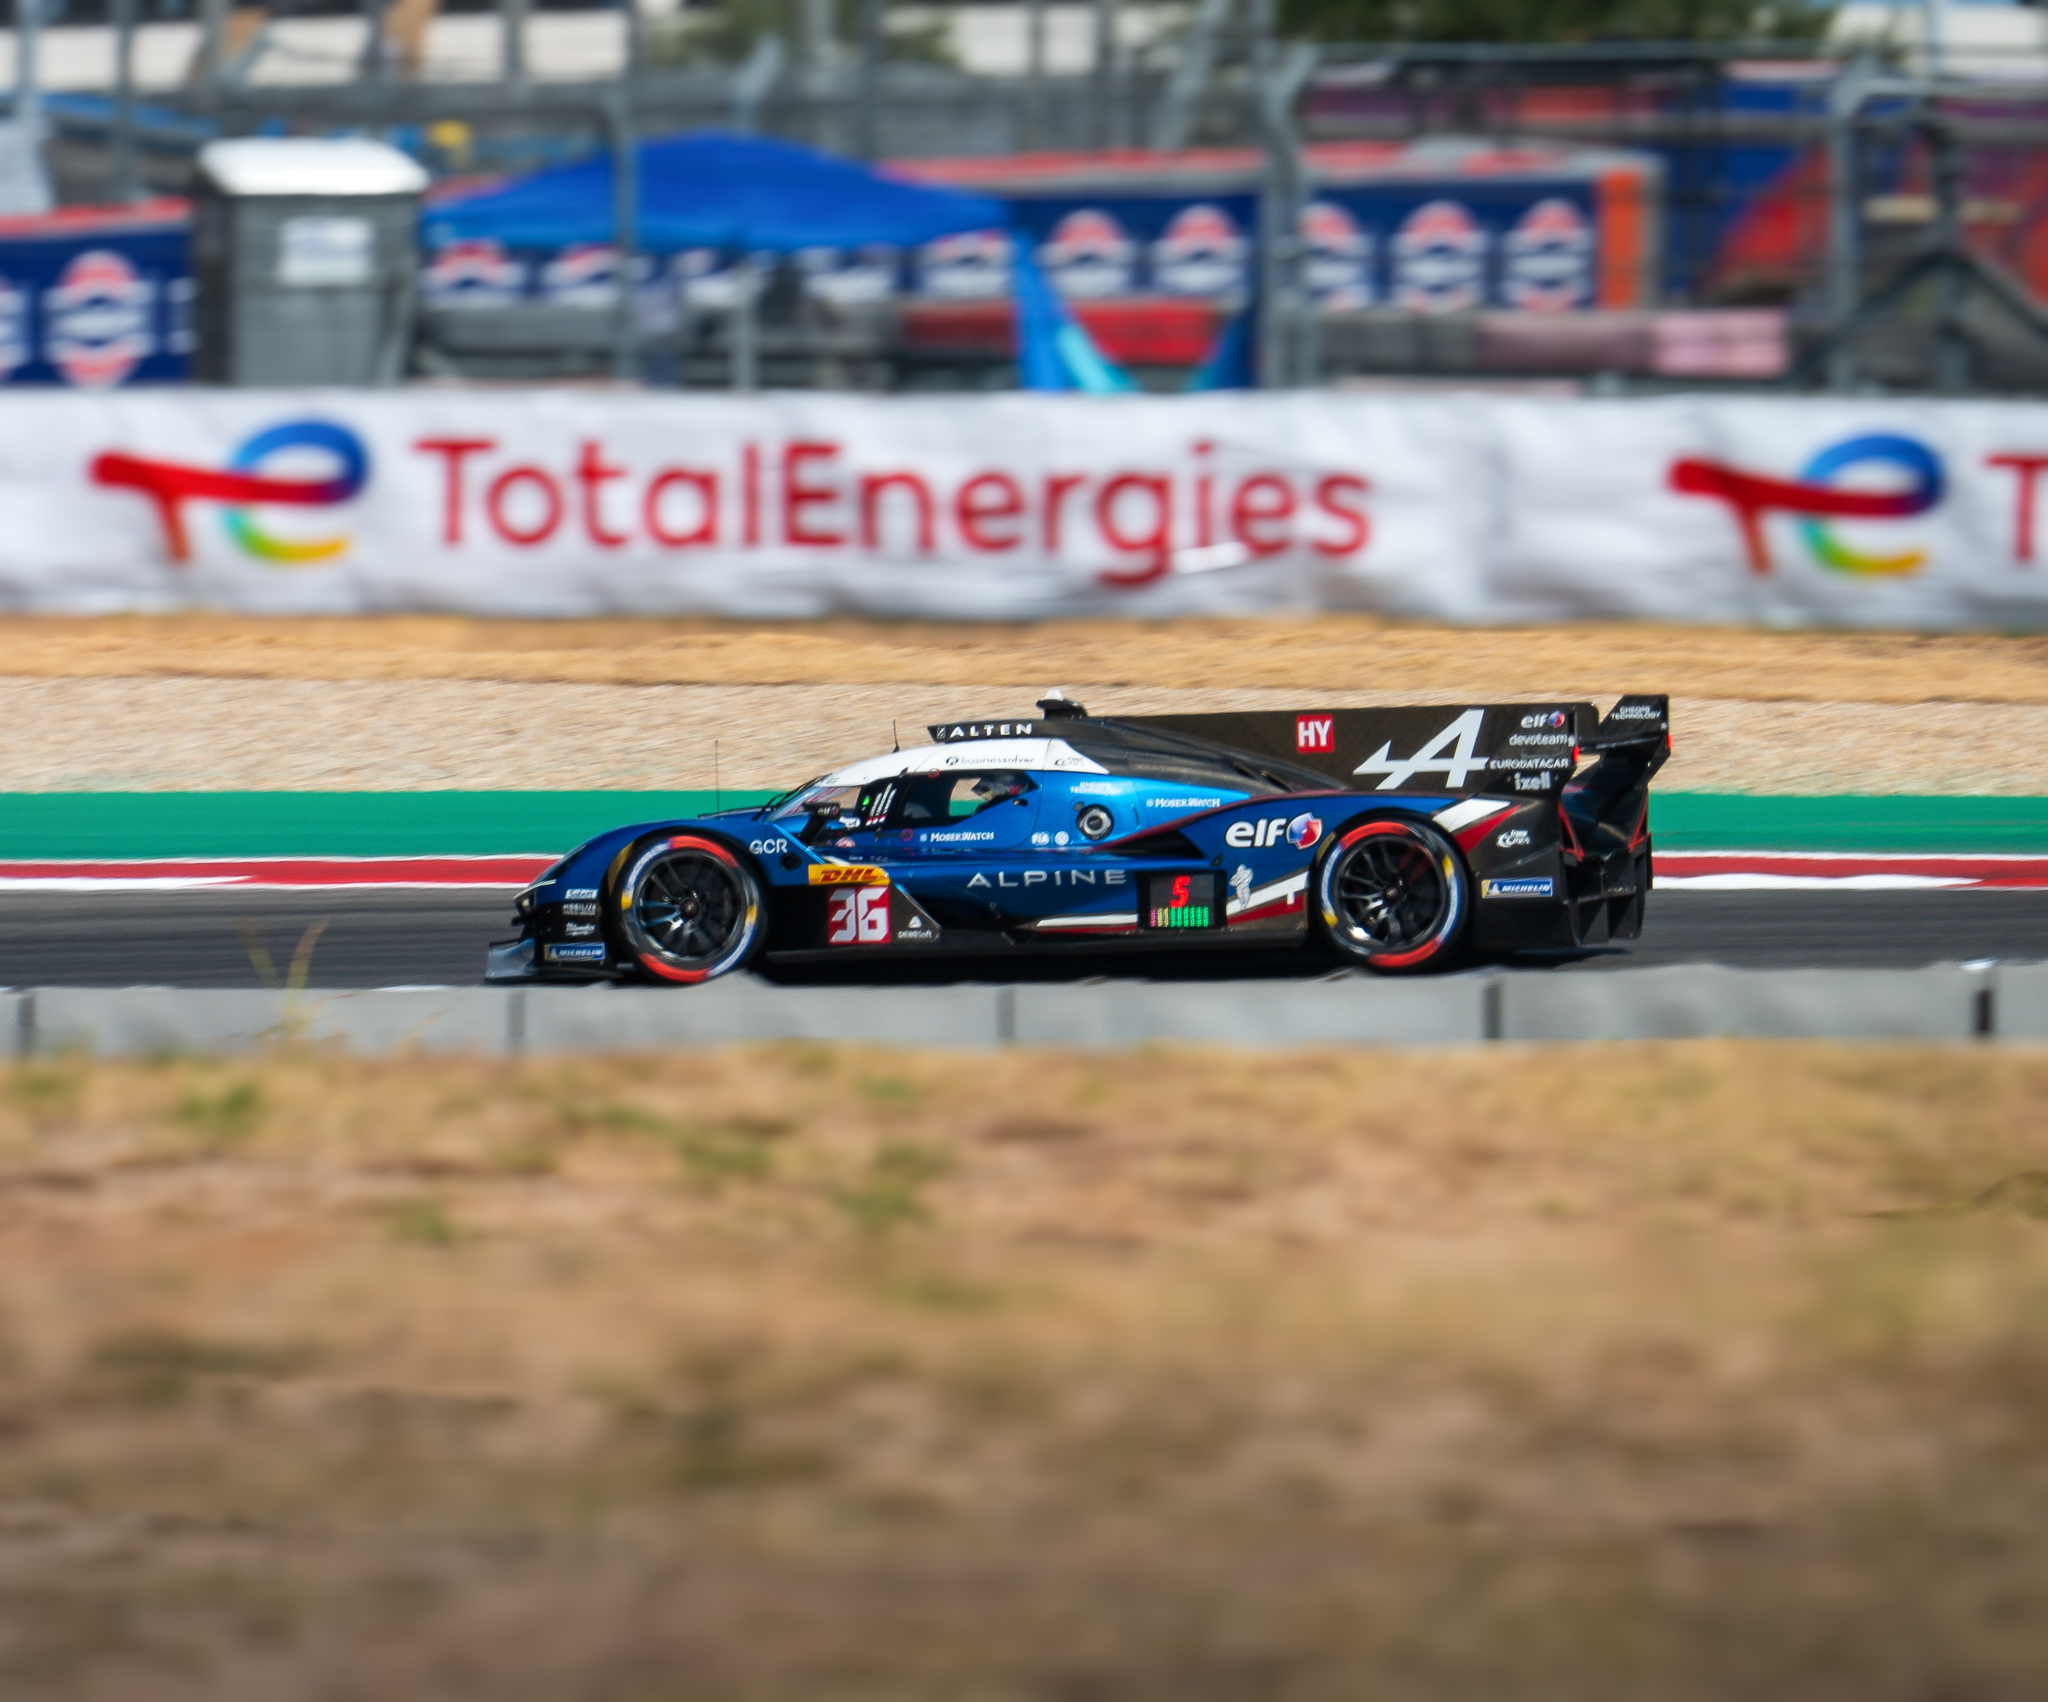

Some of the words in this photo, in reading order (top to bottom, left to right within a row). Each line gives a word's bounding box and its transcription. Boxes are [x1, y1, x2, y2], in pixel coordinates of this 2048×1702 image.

[411, 436, 1373, 590] TotalEnergies
[949, 722, 1033, 738] ALTEN
[1521, 713, 1549, 729] elf
[1298, 720, 1332, 747] HY
[1509, 733, 1568, 746] devoteam
[1514, 770, 1552, 791] ixell
[1225, 818, 1288, 848] elf
[750, 839, 788, 854] GCR
[820, 868, 880, 882] DHL
[967, 869, 1127, 889] ALPINE
[1170, 875, 1191, 908] 5
[1501, 884, 1551, 893] MICHELIN
[829, 887, 889, 942] 36
[559, 949, 603, 957] MICHELIN
